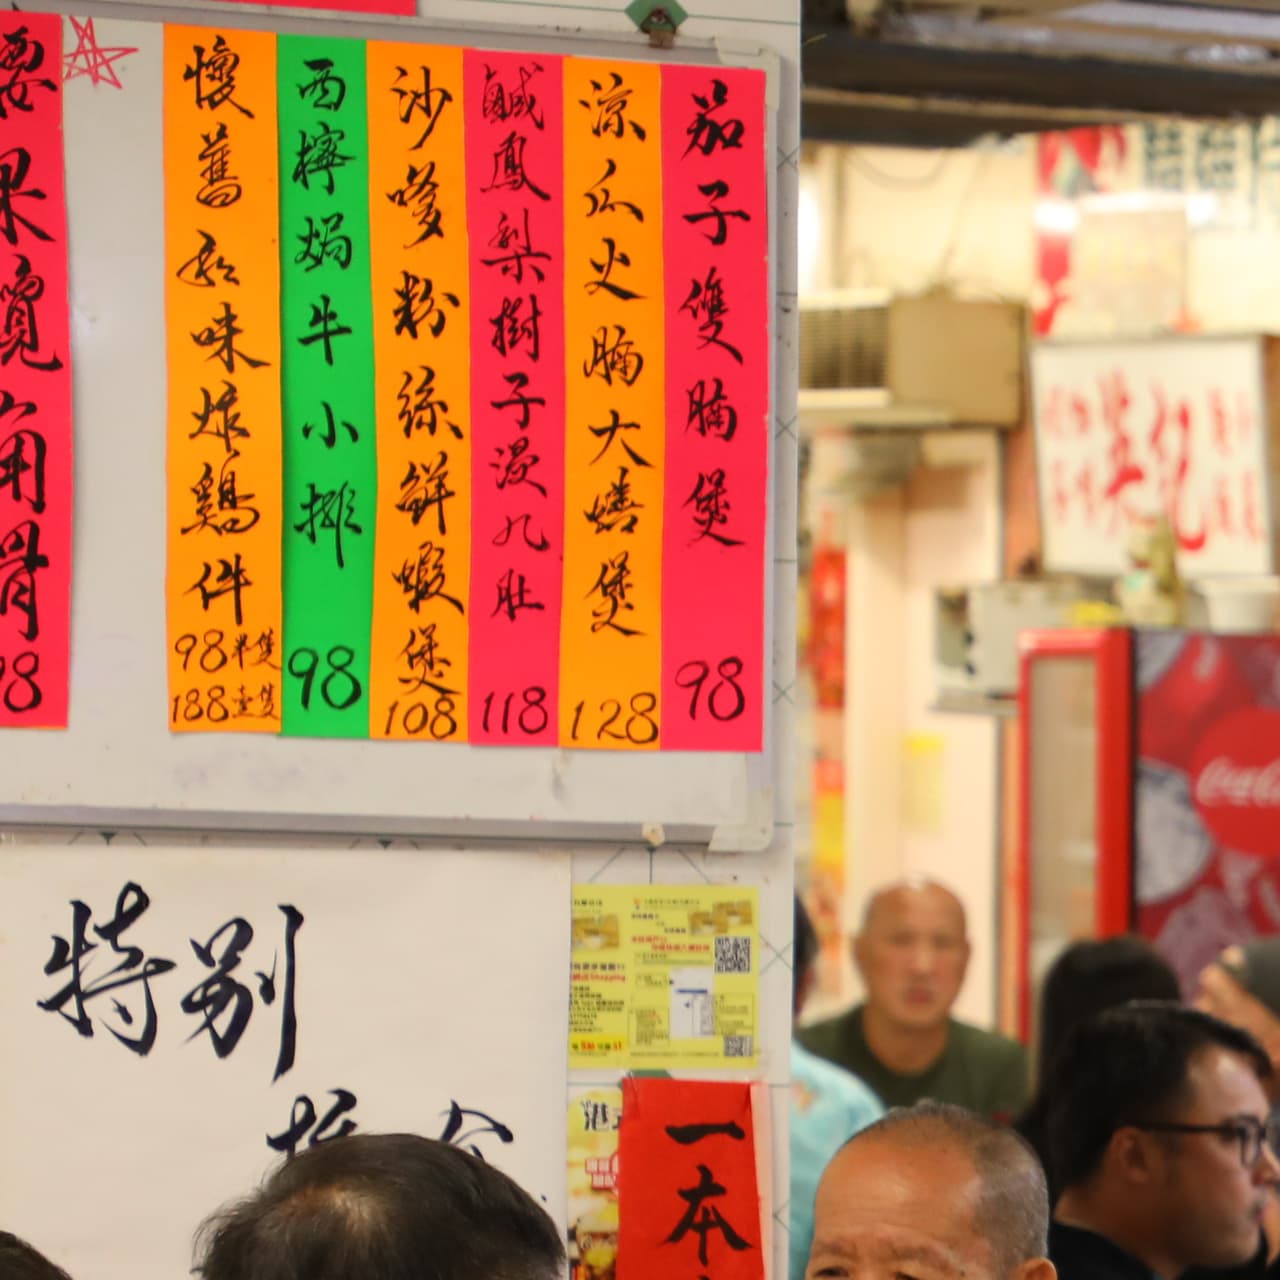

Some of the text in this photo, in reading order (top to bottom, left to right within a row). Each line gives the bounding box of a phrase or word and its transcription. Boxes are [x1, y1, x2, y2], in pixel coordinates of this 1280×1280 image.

[0, 650, 43, 713] 8
[287, 645, 363, 711] 98
[675, 655, 747, 724] 98
[384, 694, 458, 741] 108
[482, 685, 549, 735] 118
[570, 691, 659, 745] 128
[38, 881, 305, 1082] 特別
